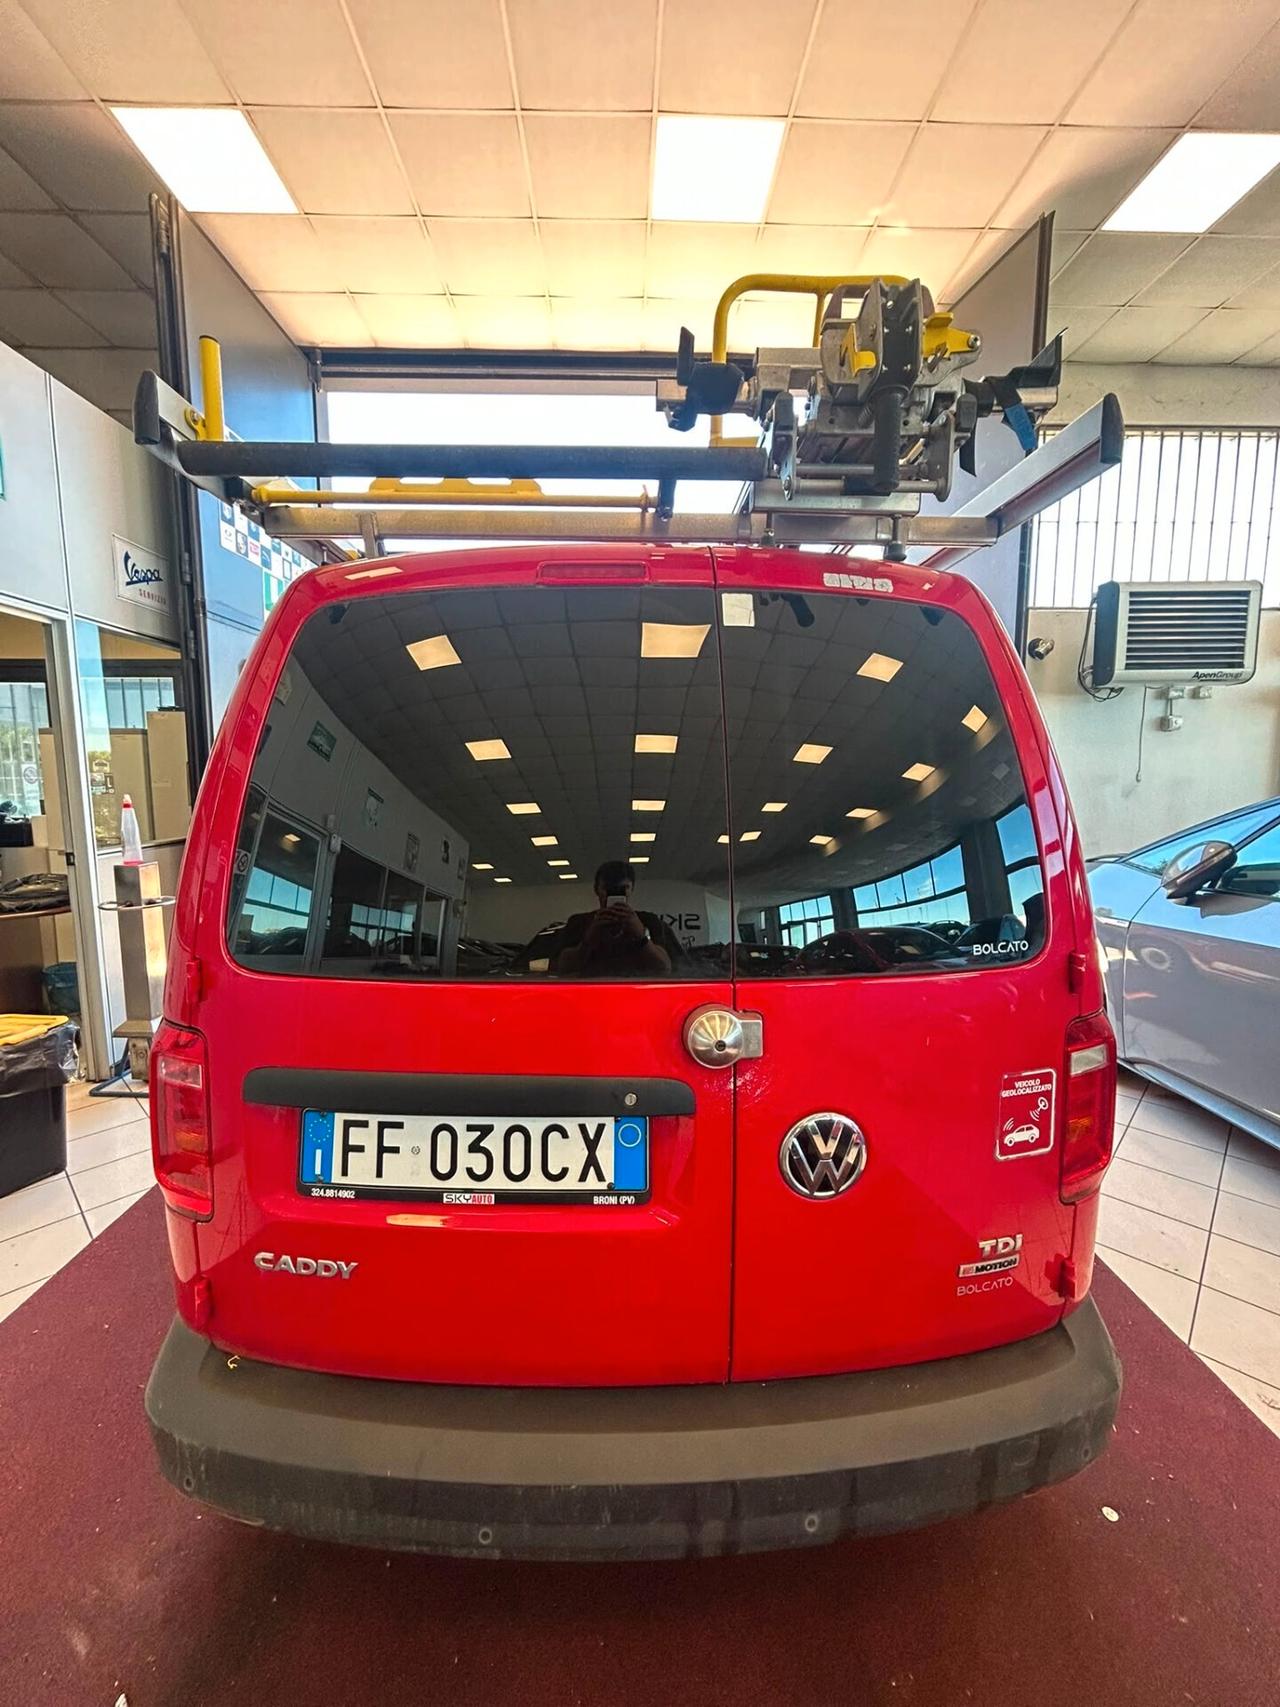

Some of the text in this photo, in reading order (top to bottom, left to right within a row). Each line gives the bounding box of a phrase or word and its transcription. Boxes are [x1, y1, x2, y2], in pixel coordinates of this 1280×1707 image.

[124, 551, 164, 586] Vespa
[1191, 671, 1243, 680] ApenGroup
[972, 940, 1029, 956] BOLCATO
[1001, 1083, 1052, 1098] GEOLOCALIZZATO
[1014, 1078, 1041, 1089] VEICOLO
[341, 1119, 405, 1179] FF
[593, 1195, 636, 1205] BRONI (PV)
[978, 1233, 1024, 1259] TDI
[253, 1251, 358, 1280] CADDY
[962, 1257, 1018, 1275] MOTION
[956, 1276, 1014, 1297] BOLCATO
